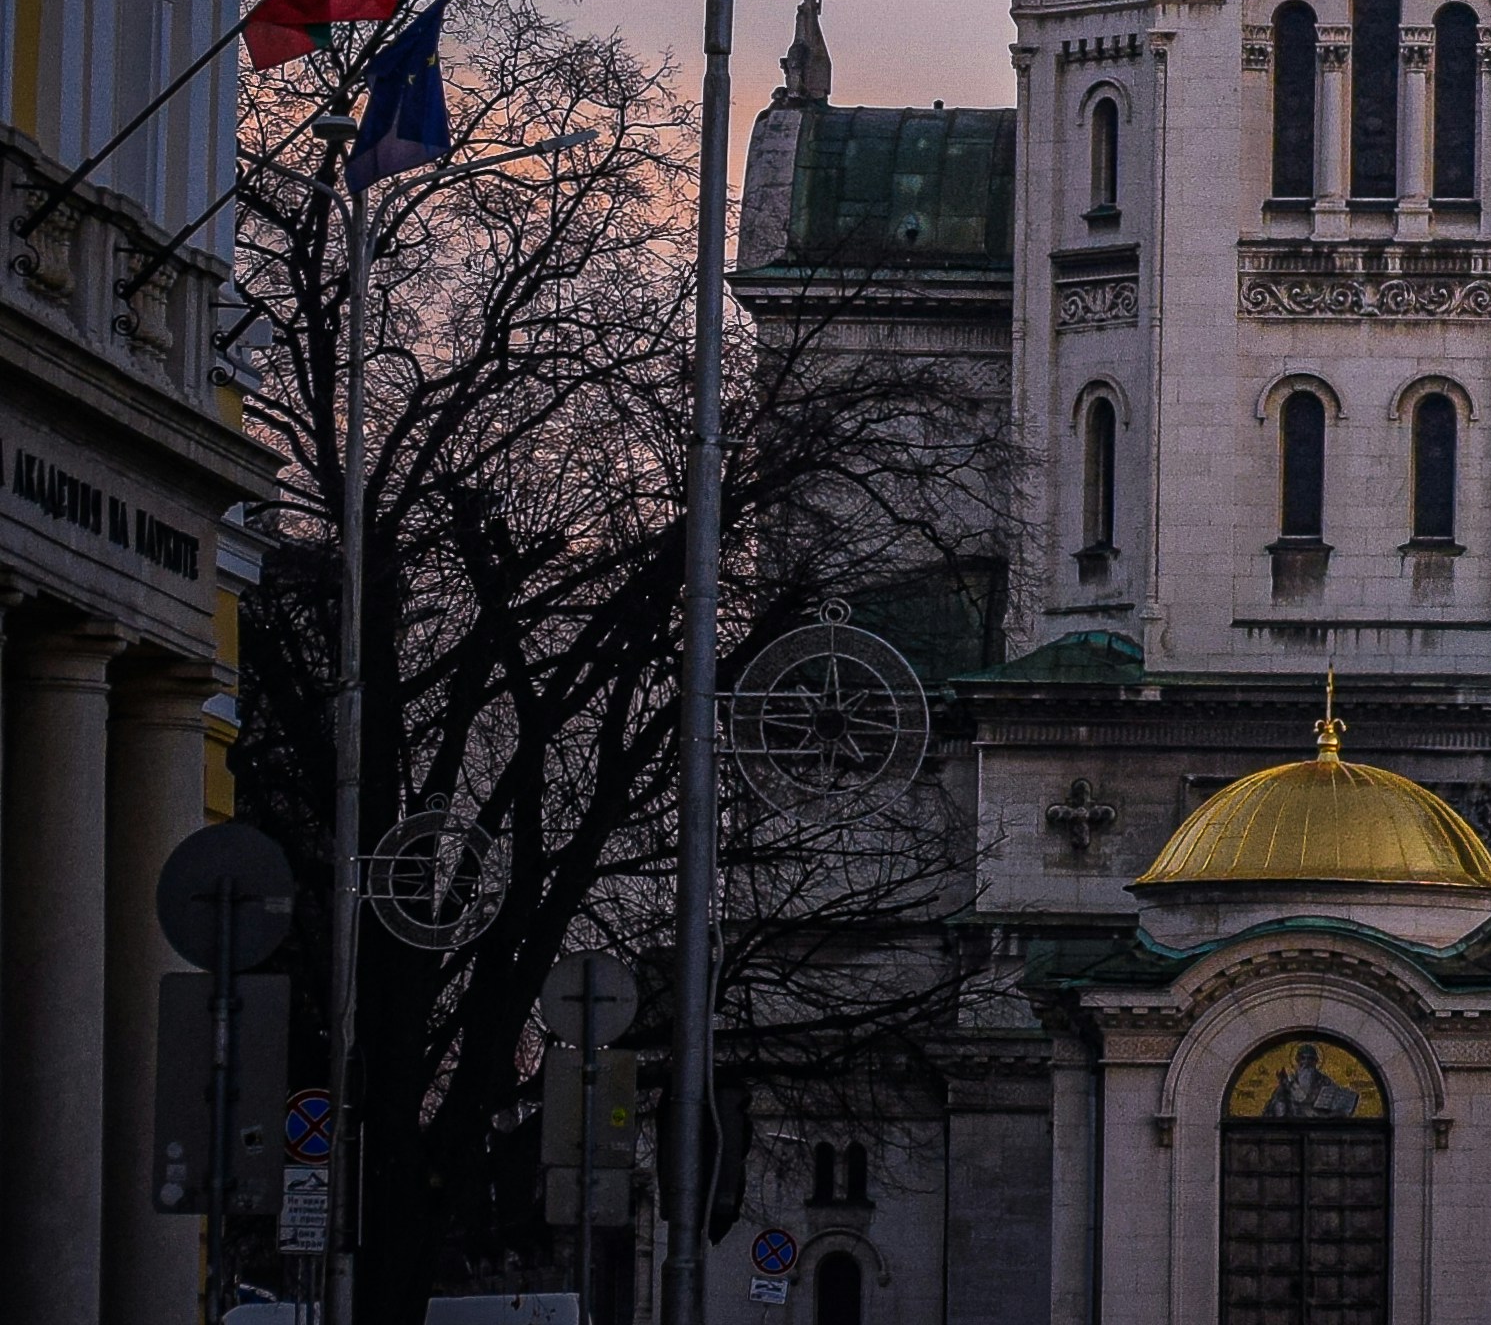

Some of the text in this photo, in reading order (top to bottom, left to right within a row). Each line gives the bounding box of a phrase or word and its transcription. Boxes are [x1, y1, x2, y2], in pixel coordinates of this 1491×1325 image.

[12, 448, 102, 536] АКАДЕМИЯ
[109, 495, 129, 549] НА
[135, 509, 199, 580] НАУКИТЕ
